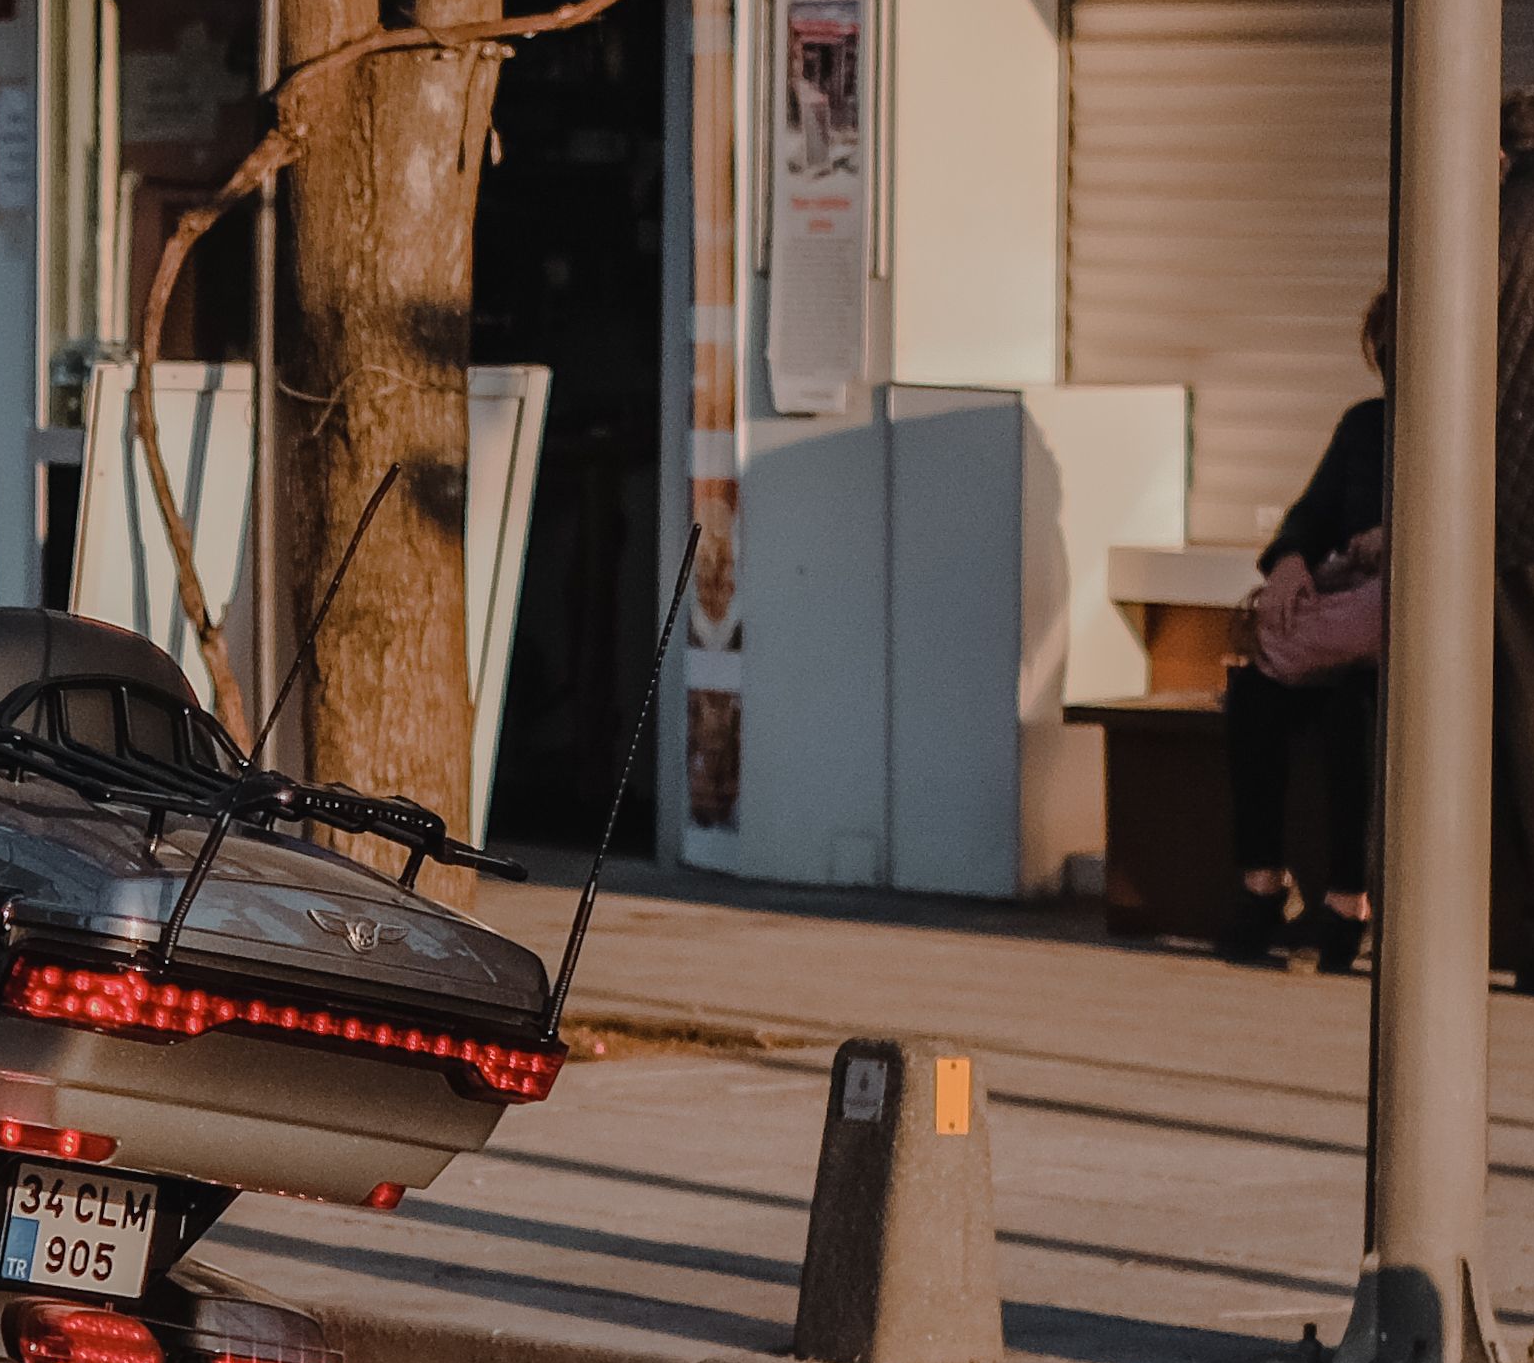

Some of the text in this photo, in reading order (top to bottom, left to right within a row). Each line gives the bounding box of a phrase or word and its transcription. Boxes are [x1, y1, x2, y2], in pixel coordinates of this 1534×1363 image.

[20, 1174, 152, 1232] 34 CLM
[6, 1256, 28, 1279] TR
[44, 1236, 115, 1280] 905
